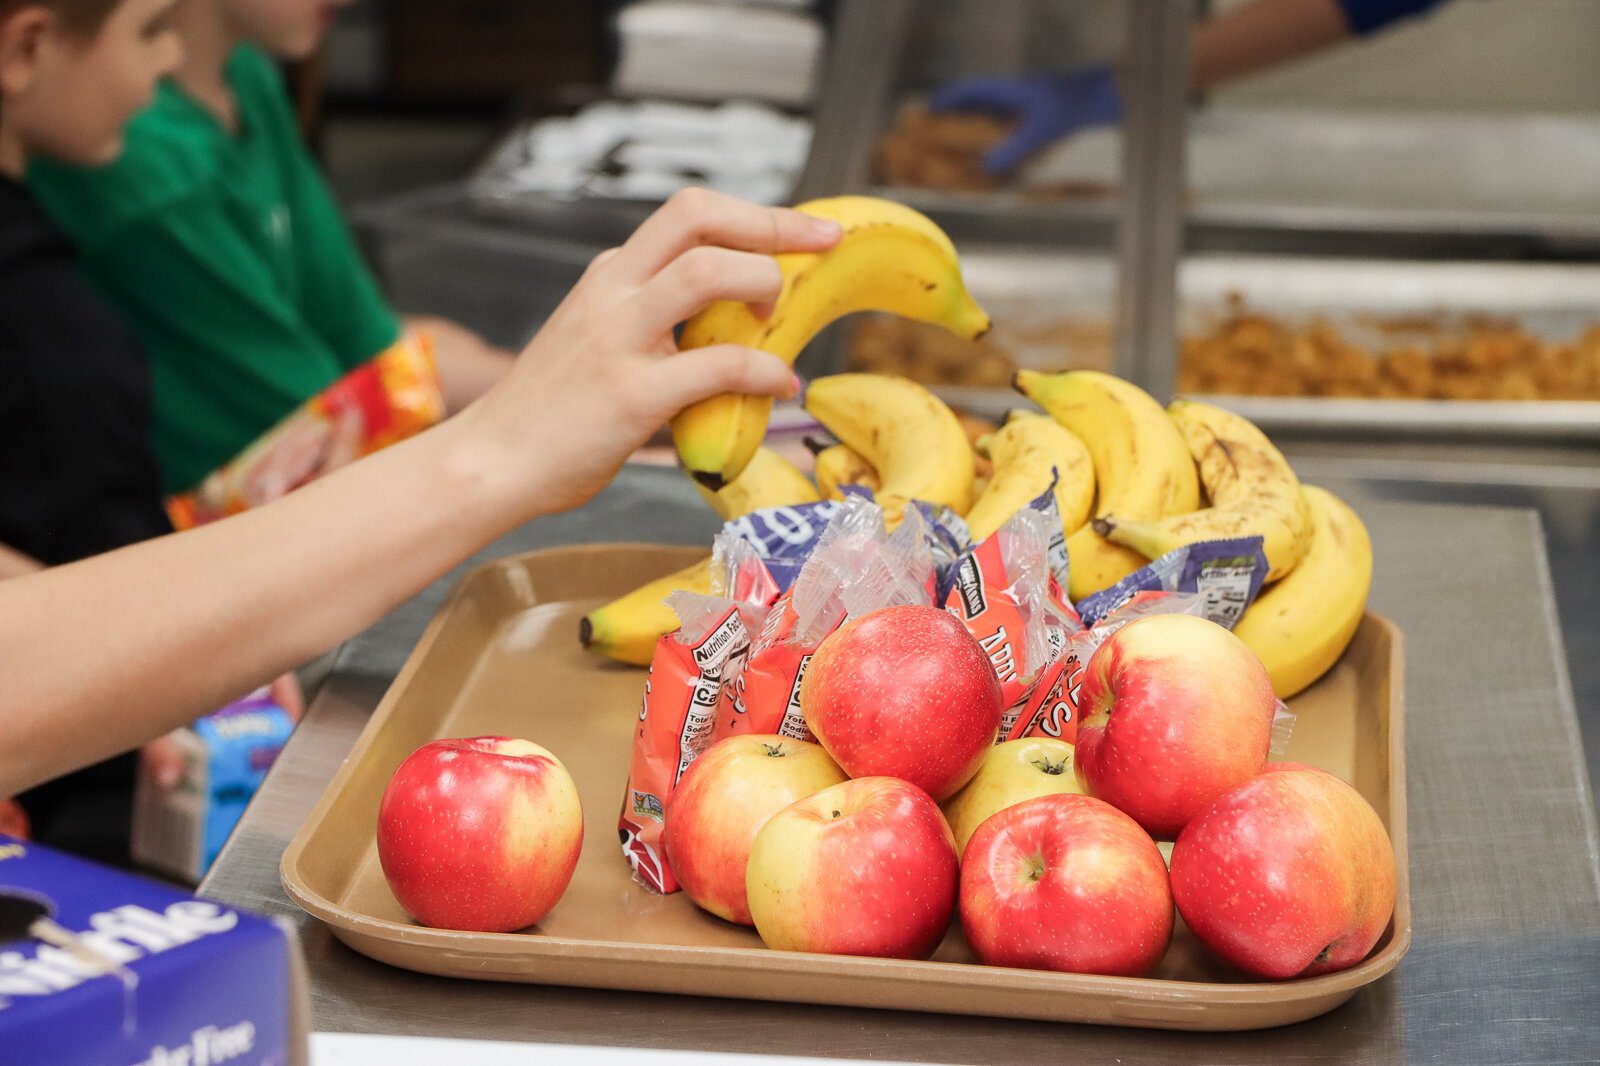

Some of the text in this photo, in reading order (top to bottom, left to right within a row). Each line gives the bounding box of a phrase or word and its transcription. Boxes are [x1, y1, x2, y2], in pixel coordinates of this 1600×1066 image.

[696, 629, 731, 662] Nutrition
[726, 616, 743, 637] Fact
[788, 714, 807, 725] Tota
